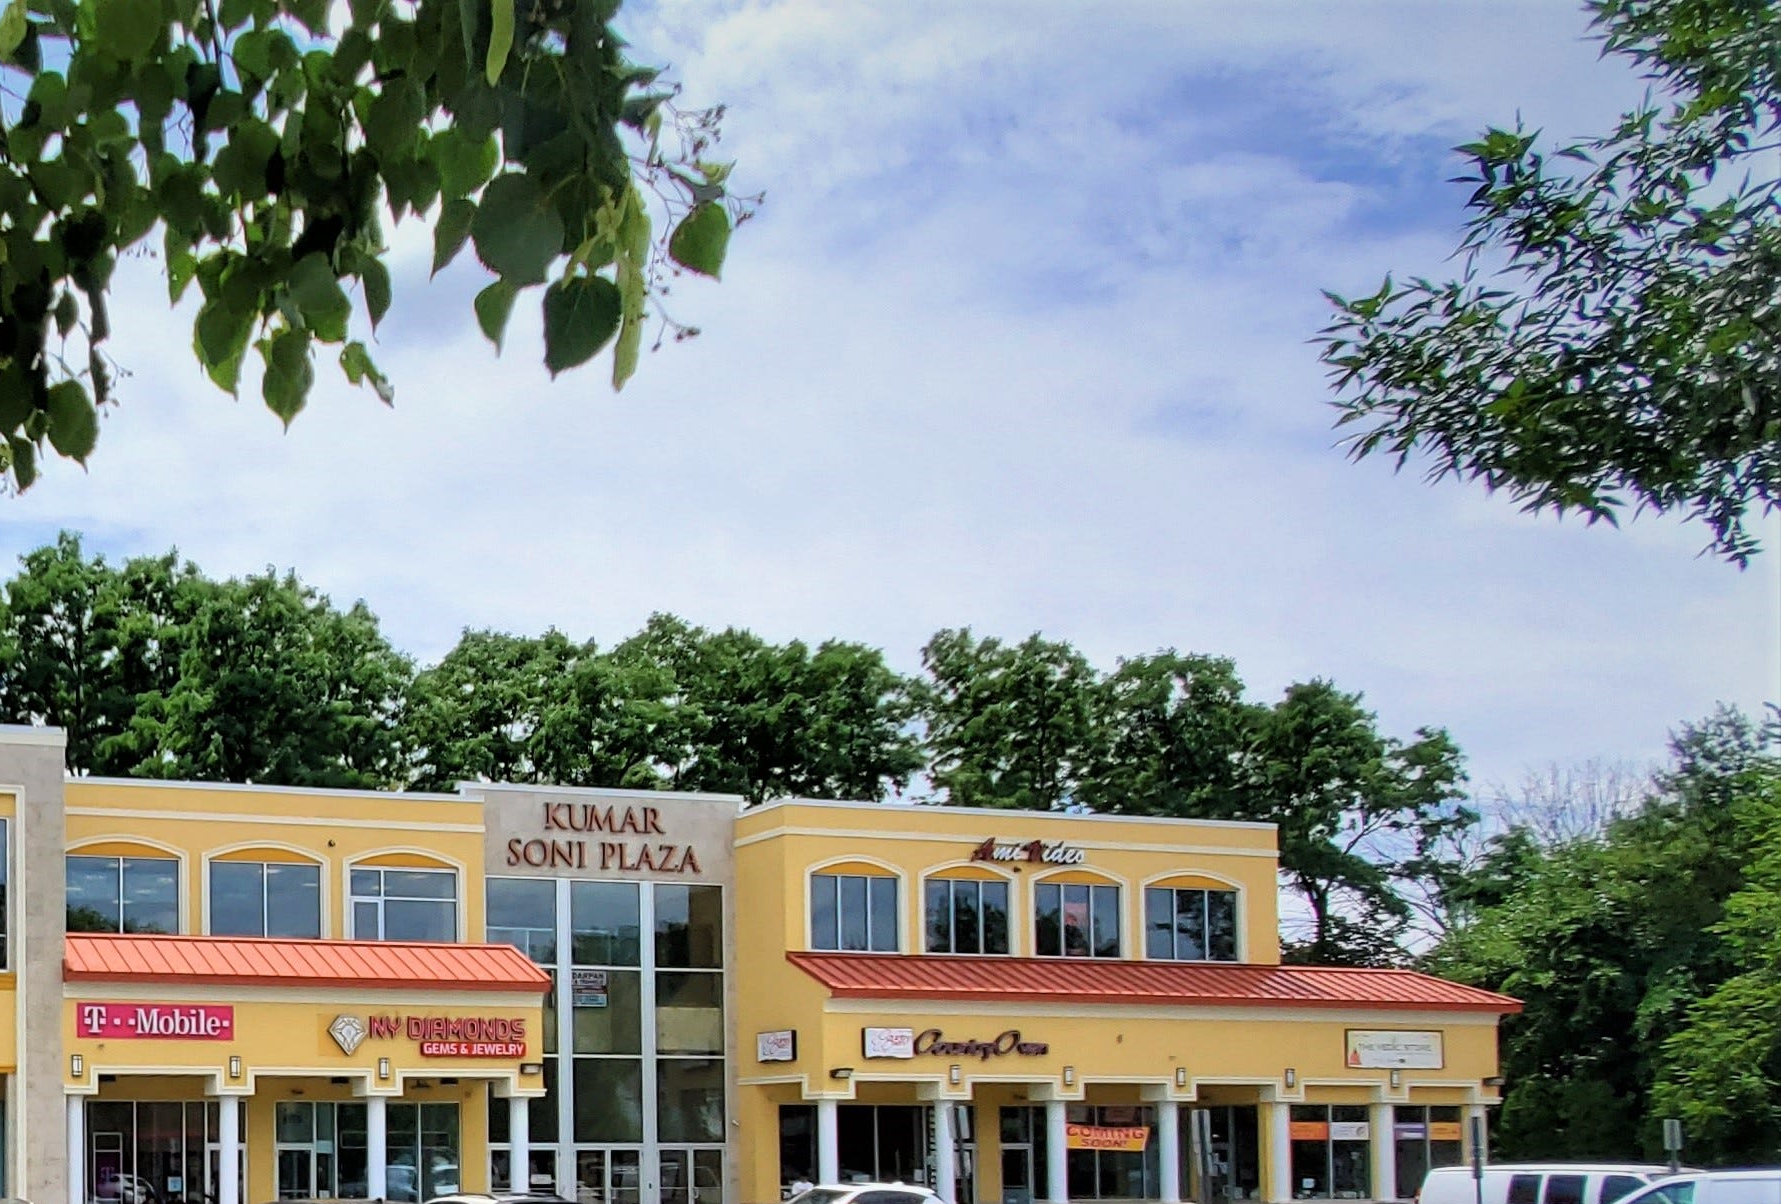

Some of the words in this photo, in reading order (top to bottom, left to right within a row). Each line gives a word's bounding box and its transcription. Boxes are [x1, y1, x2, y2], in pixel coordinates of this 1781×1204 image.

[543, 802, 666, 834] KUMAR
[507, 838, 588, 868] SONI
[599, 841, 701, 874] PLAZA
[369, 1016, 402, 1038] NY
[407, 1016, 526, 1040] DIAMONDS
[423, 1043, 457, 1055] GEMS
[460, 1044, 469, 1055] &
[472, 1044, 524, 1056] JEWELRY
[1067, 1127, 1144, 1139] COMING
